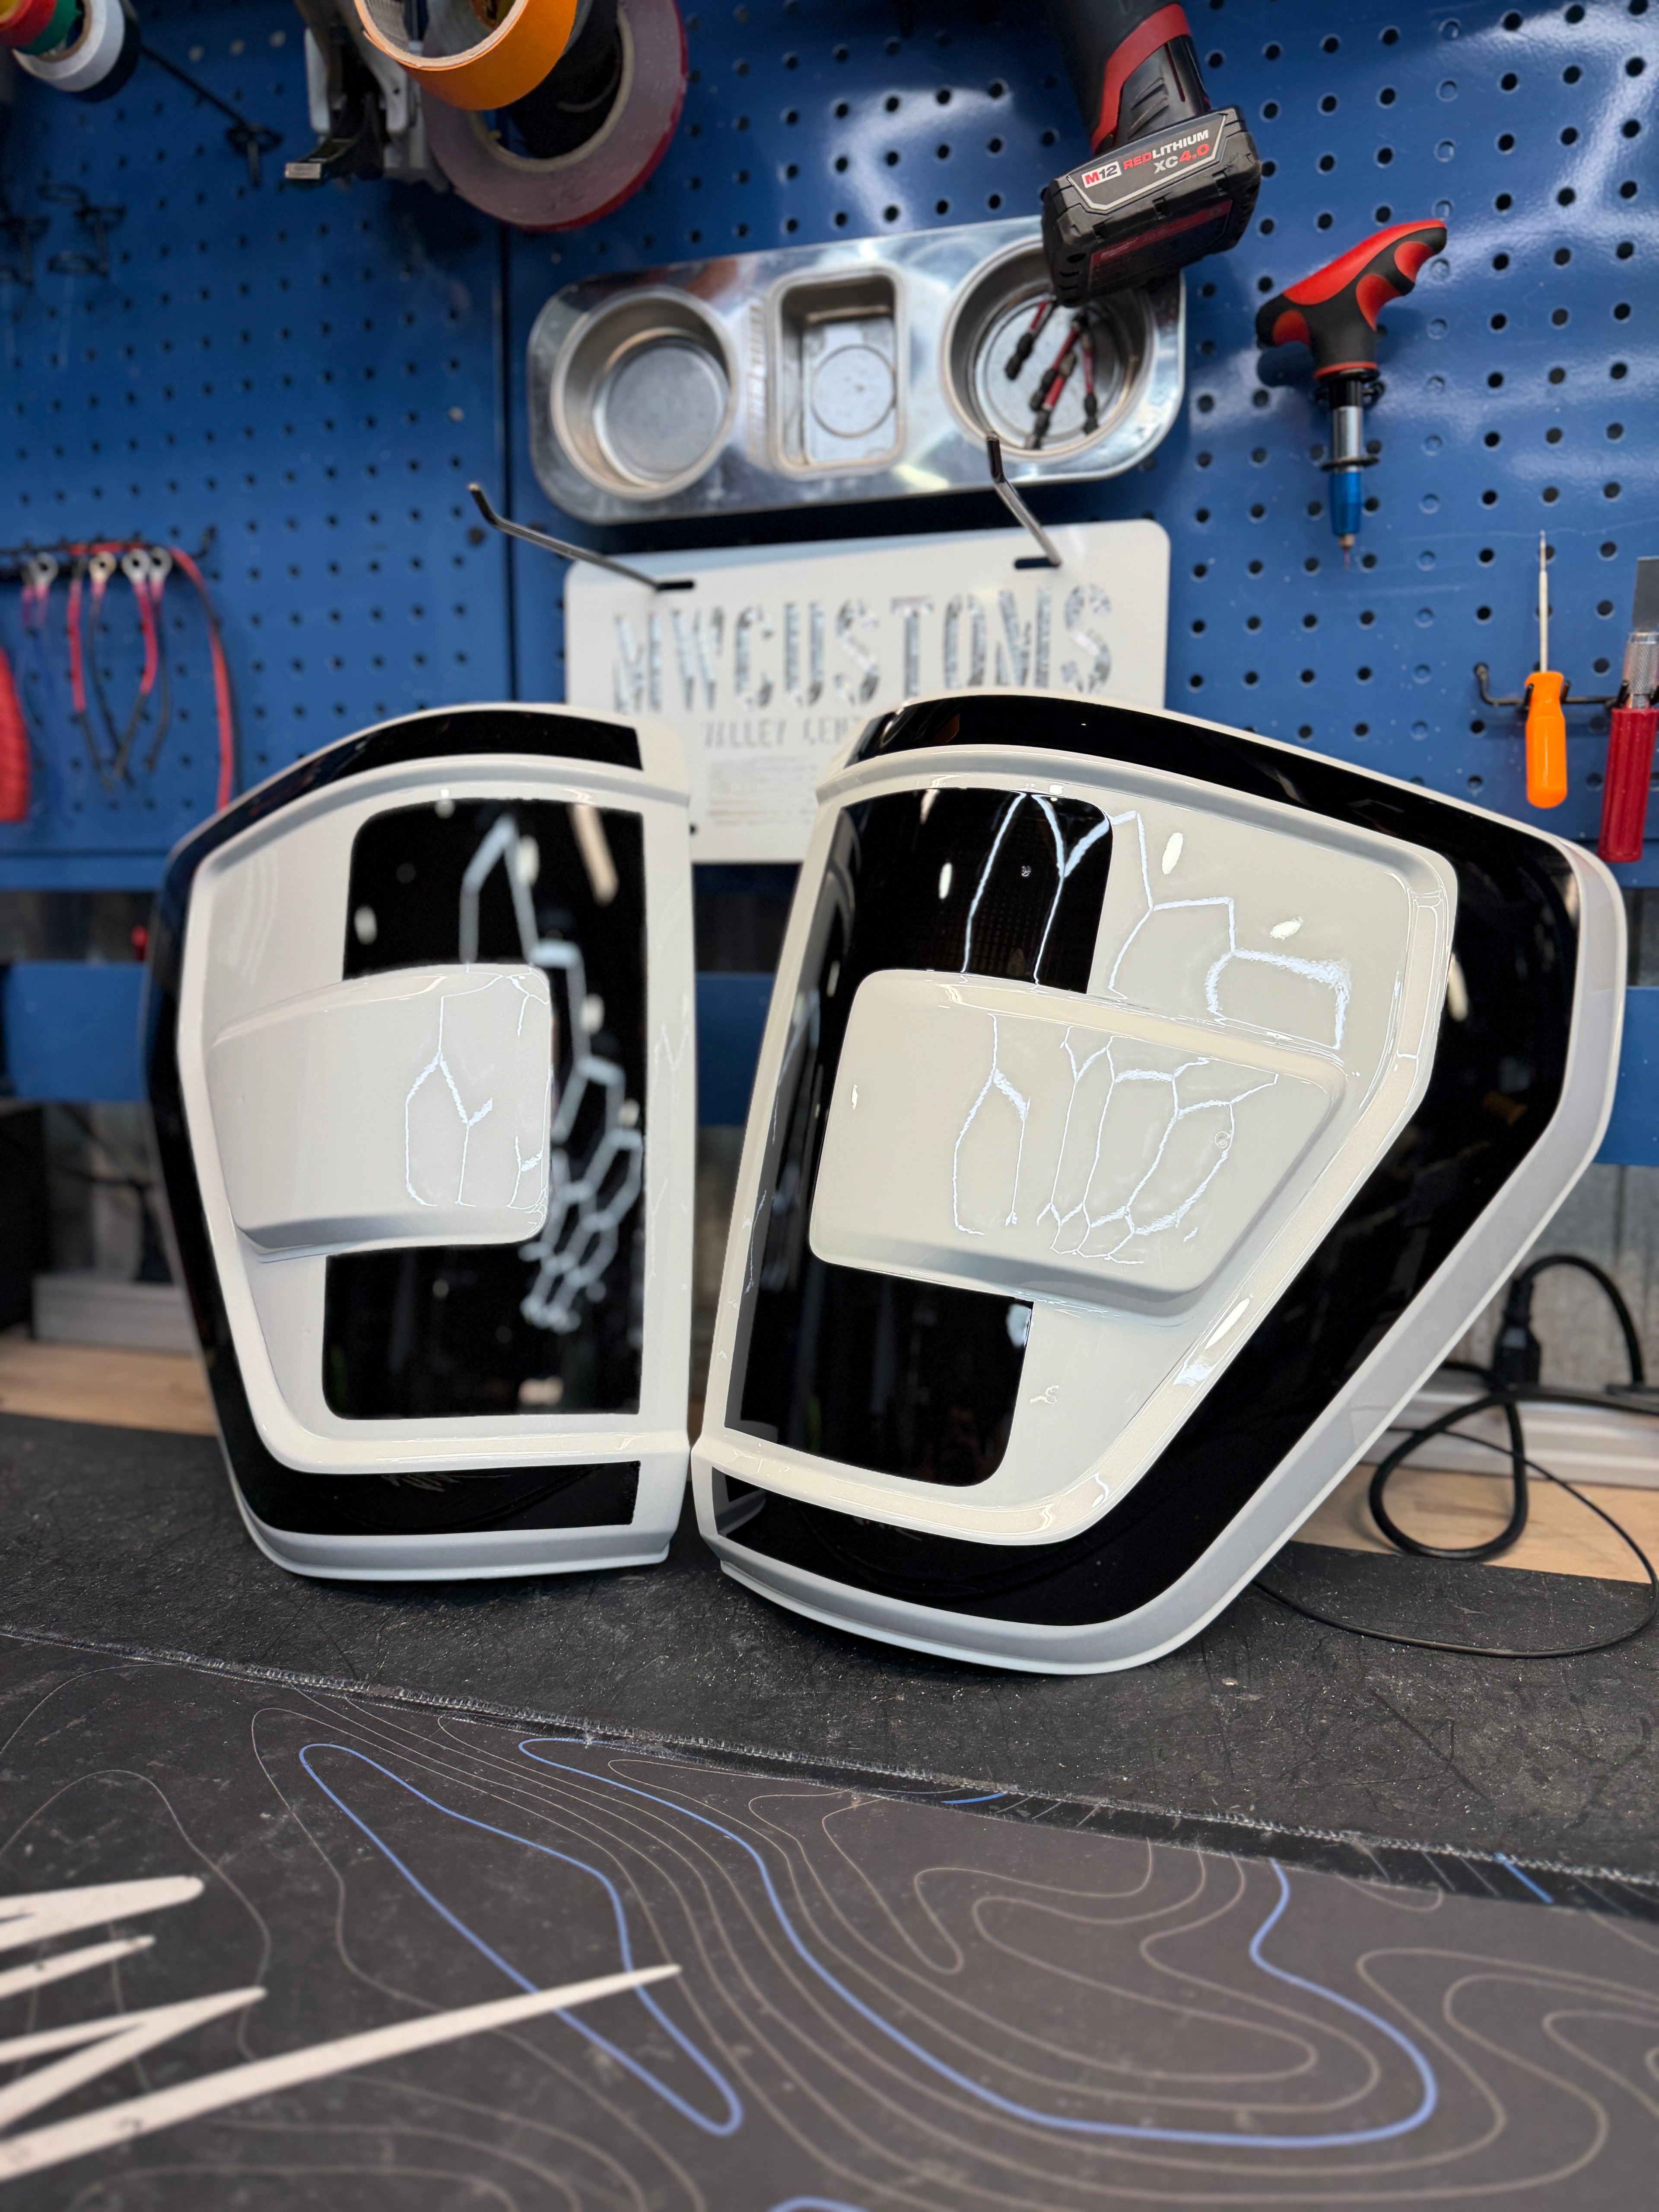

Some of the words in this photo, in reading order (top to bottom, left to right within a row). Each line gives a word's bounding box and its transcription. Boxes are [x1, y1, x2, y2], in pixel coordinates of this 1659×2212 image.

[1084, 165, 1118, 184] M12
[1123, 130, 1209, 170] REDLITHIUM
[1154, 143, 1209, 174] XC4.0
